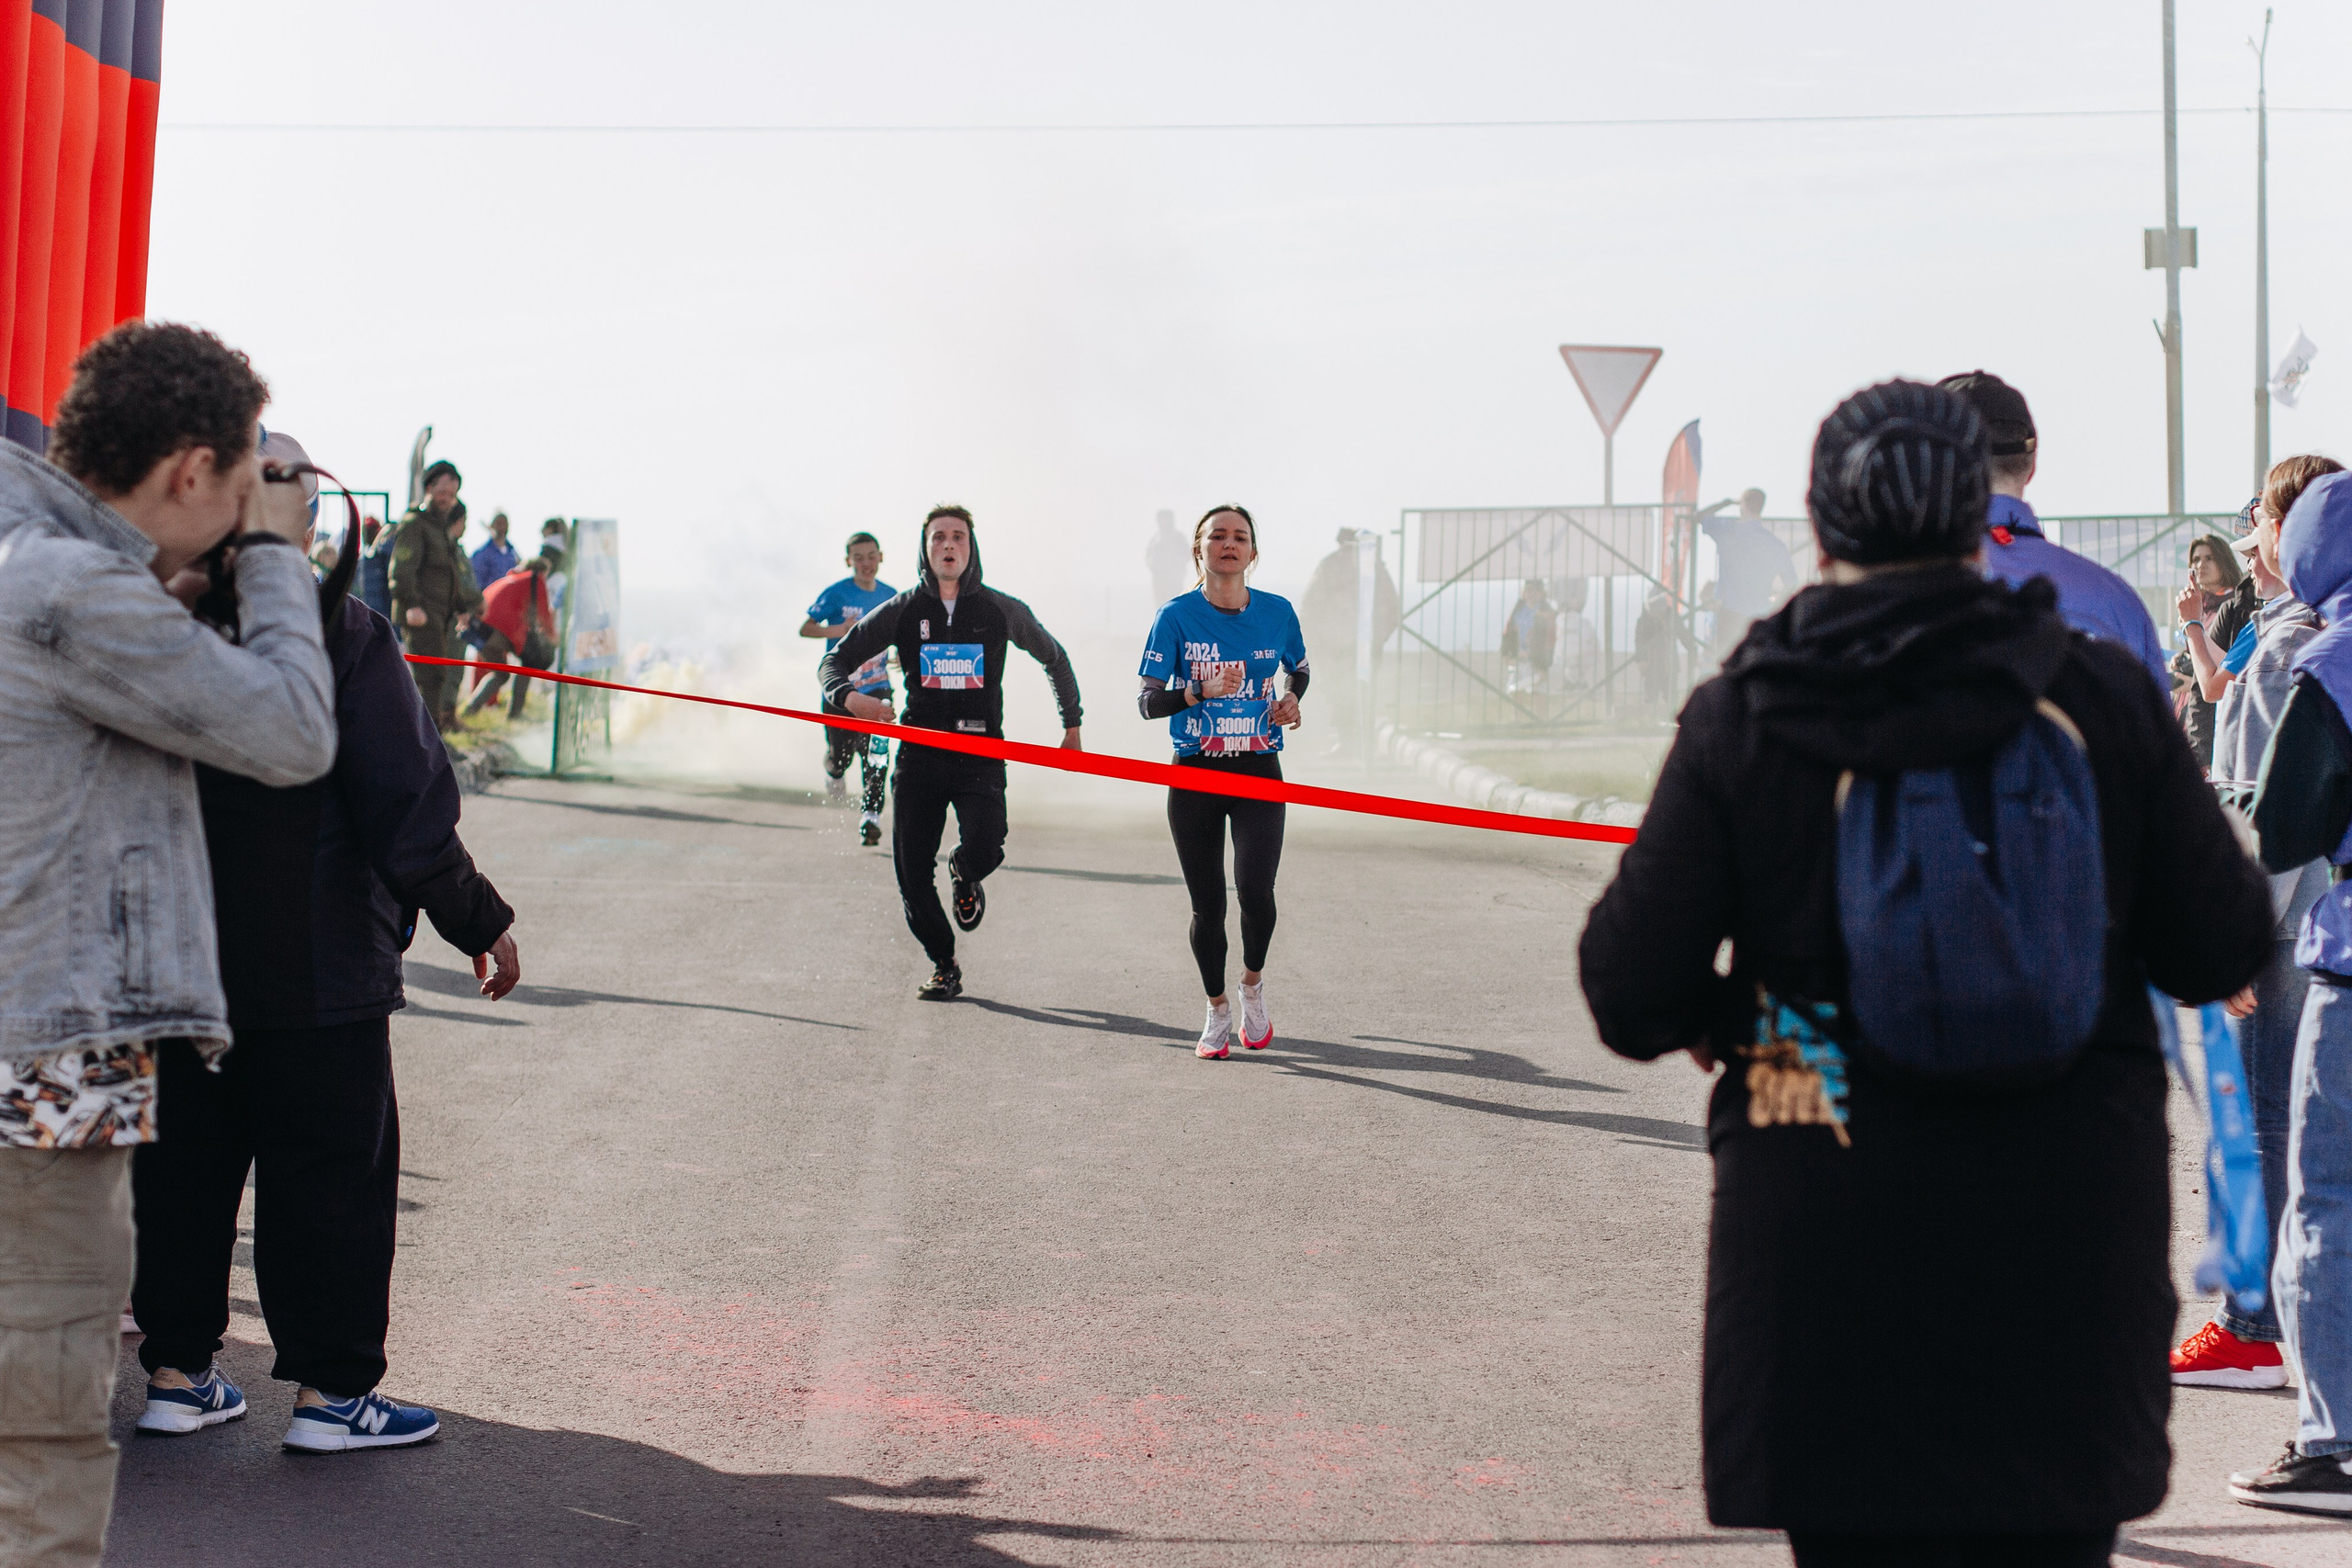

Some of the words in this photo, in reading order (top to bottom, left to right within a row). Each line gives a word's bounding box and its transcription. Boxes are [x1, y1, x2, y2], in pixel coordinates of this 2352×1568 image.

[1144, 649, 1163, 662] ПСБ
[1184, 642, 1220, 661] 2024
[933, 660, 972, 674] 30006
[1216, 717, 1255, 734] 30001
[358, 1404, 390, 1435] N
